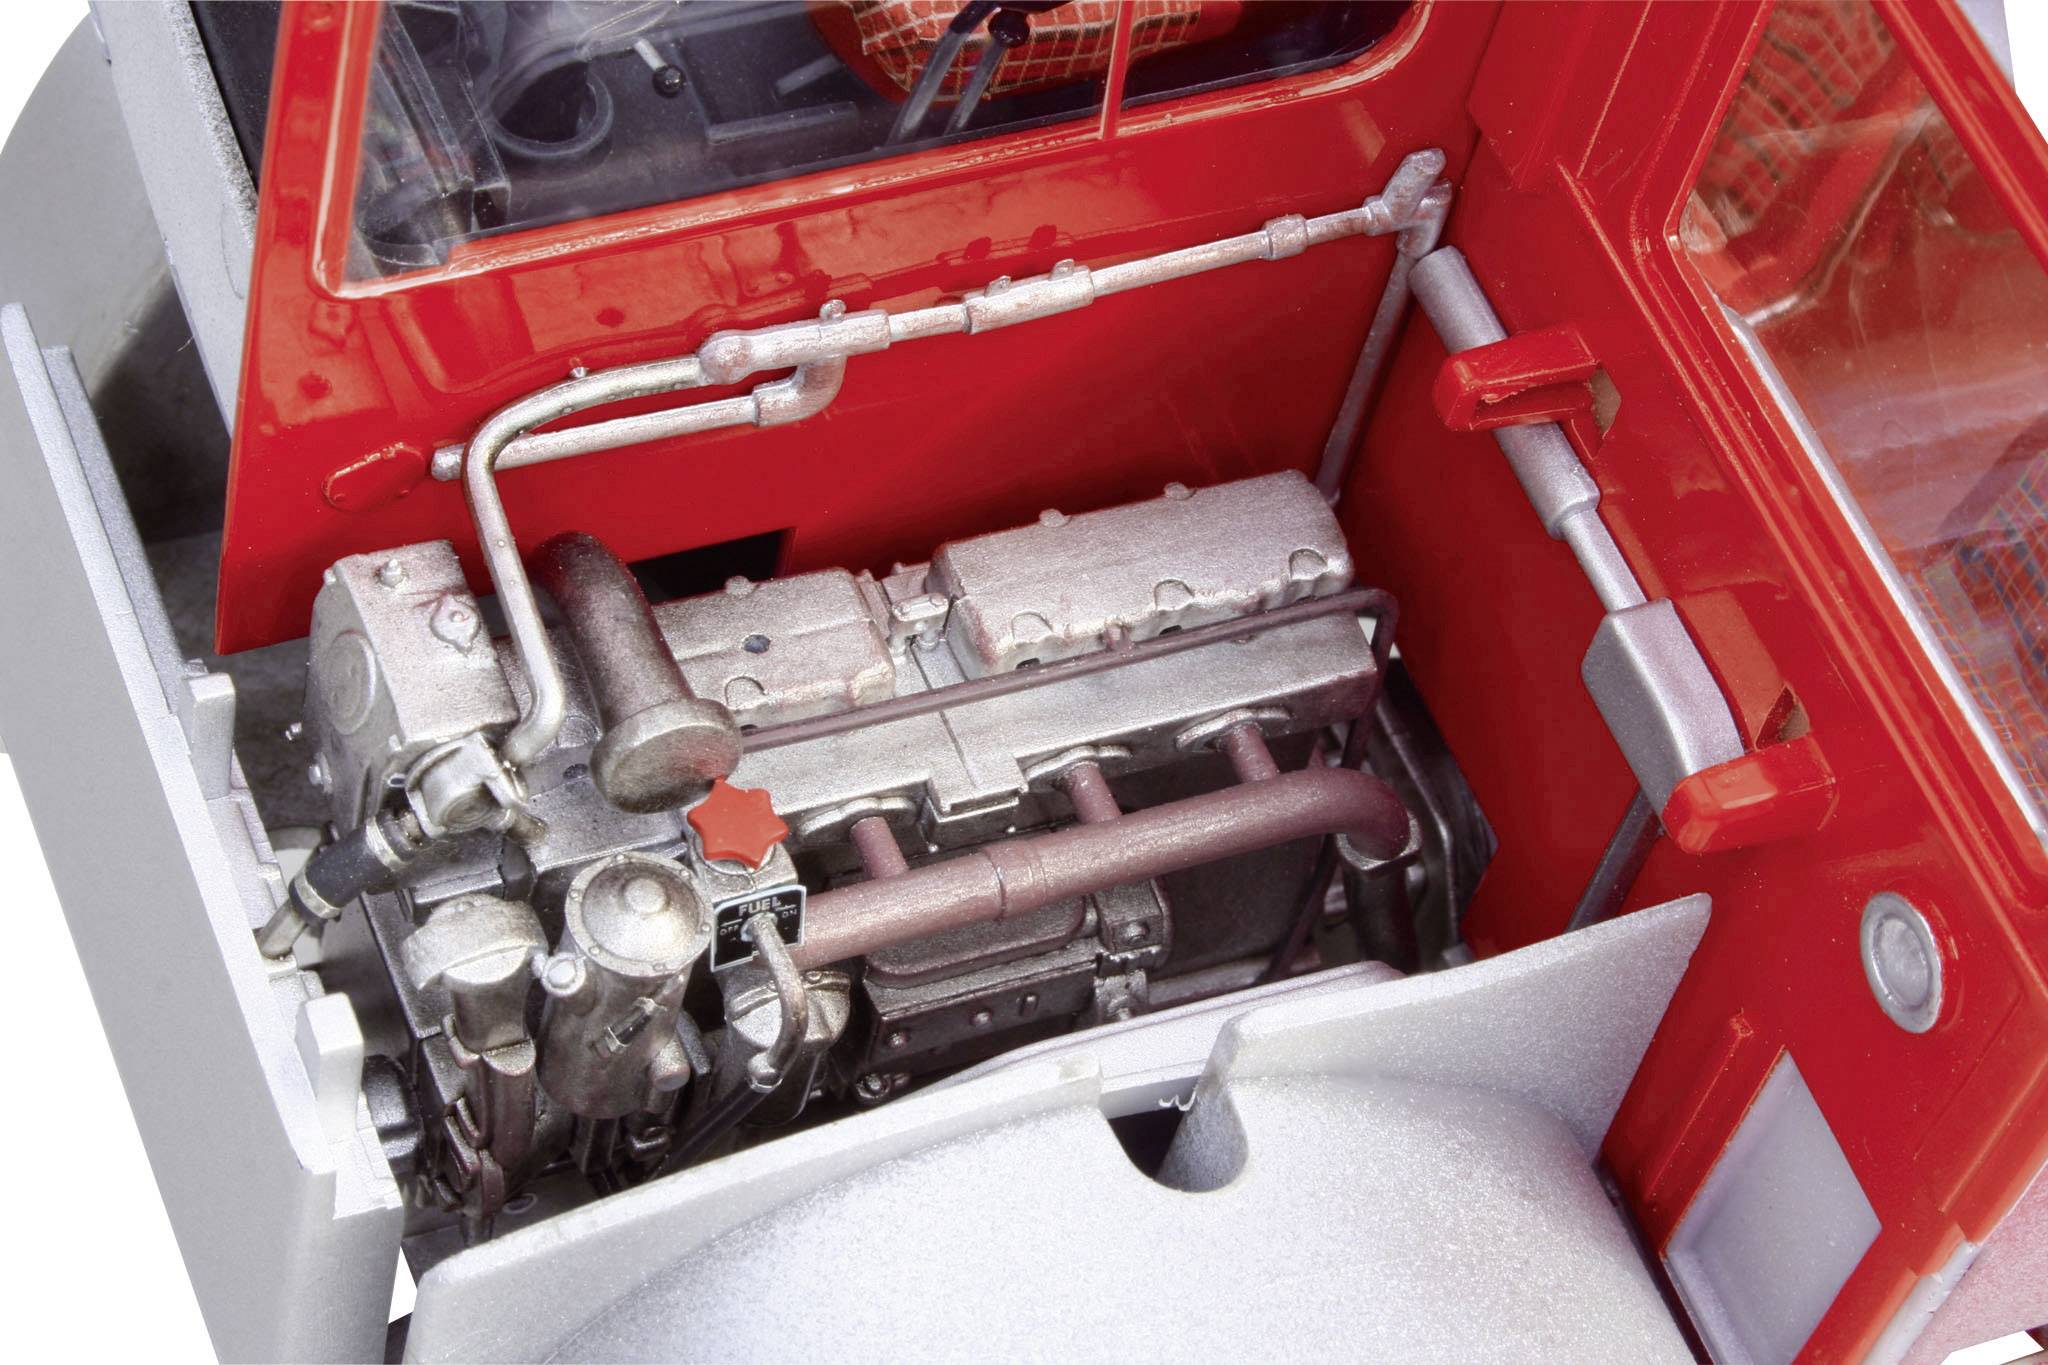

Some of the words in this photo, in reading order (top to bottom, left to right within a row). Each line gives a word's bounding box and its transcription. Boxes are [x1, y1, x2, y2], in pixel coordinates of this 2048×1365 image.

[738, 896, 781, 916] FUEL
[782, 908, 797, 918] ON
[719, 924, 739, 936] OFF
